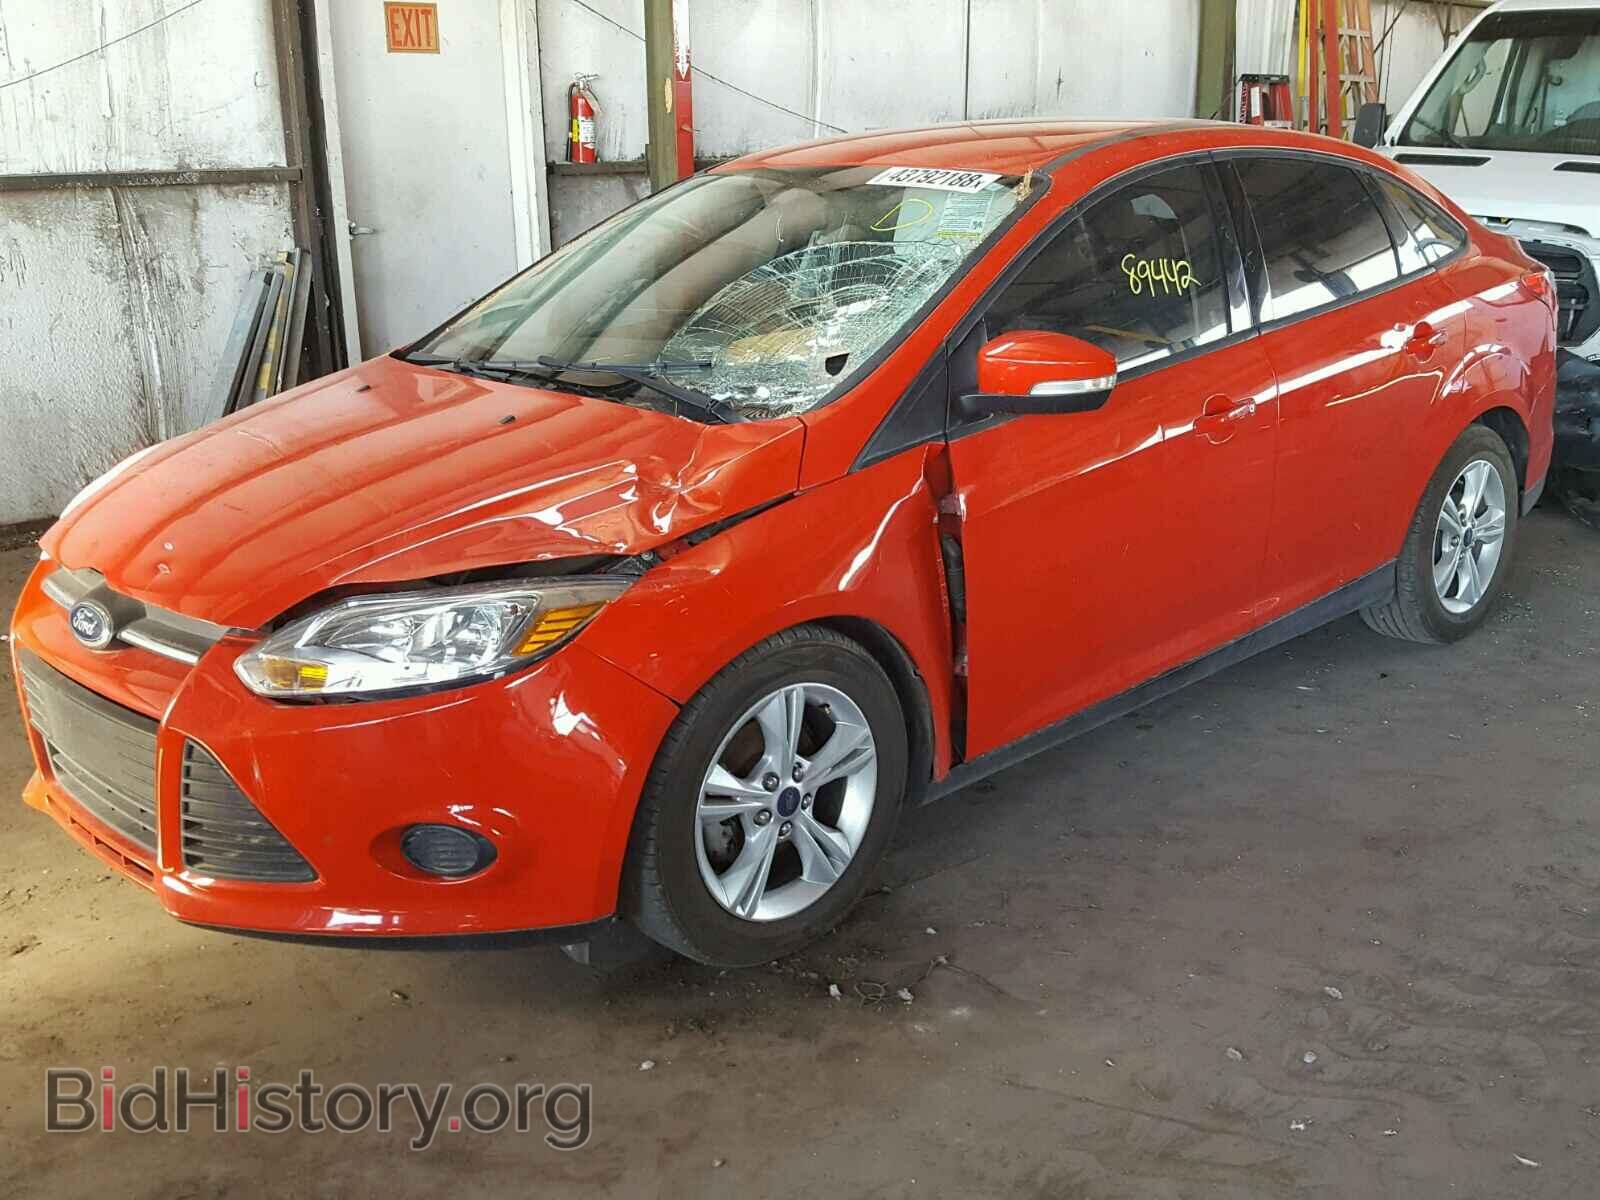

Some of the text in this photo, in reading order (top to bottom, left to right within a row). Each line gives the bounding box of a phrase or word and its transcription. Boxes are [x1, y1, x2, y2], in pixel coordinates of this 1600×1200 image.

[389, 8, 433, 47] EXIT
[1121, 253, 1203, 297] 89442
[72, 607, 98, 635] Ford
